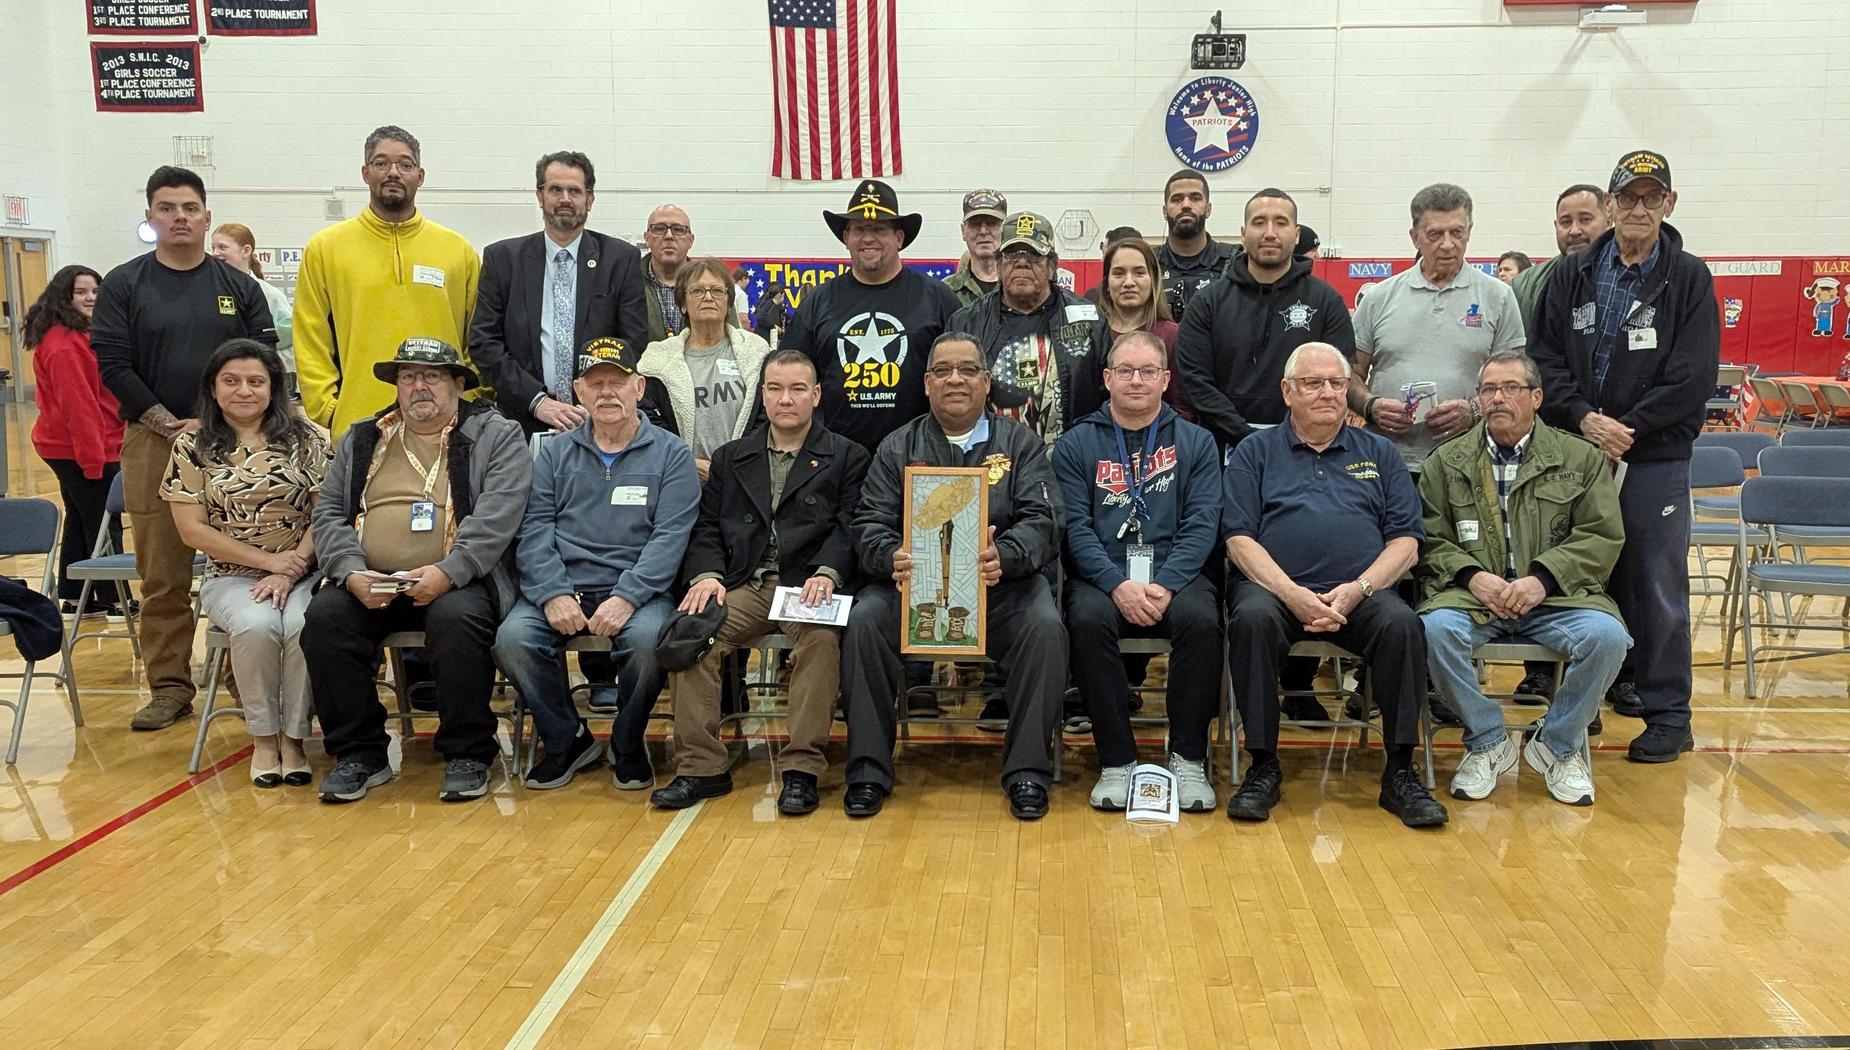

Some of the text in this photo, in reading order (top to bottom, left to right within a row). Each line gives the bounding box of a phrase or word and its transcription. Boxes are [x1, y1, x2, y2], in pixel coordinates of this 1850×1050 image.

[107, 5, 136, 15] PLACE
[138, 4, 190, 15] CONFERENCE
[225, 8, 252, 19] PLACE
[254, 9, 309, 20] TOURNAMENT
[108, 17, 136, 26] PLACE
[138, 16, 190, 26] TOURNAMENT
[102, 55, 125, 71] 2013
[165, 54, 190, 70] 2013
[114, 68, 177, 79] GIRLS SOCCER
[111, 79, 139, 89] PLACE
[140, 78, 195, 88] CONFERENCE
[115, 89, 141, 99] PLACE
[142, 88, 196, 99] TOURNAMENT
[1168, 77, 1257, 117] Welcome to Liberty Junior High
[1192, 118, 1233, 126] PATRIOTS
[1174, 145, 1250, 171] Home of the PATRIOTS
[283, 251, 301, 262] P.E.
[1350, 263, 1392, 275] NAVY
[1728, 261, 1781, 274] GUARD
[843, 361, 900, 388] 250
[694, 380, 747, 409] RMY
[860, 392, 897, 400] U.S. ARMY
